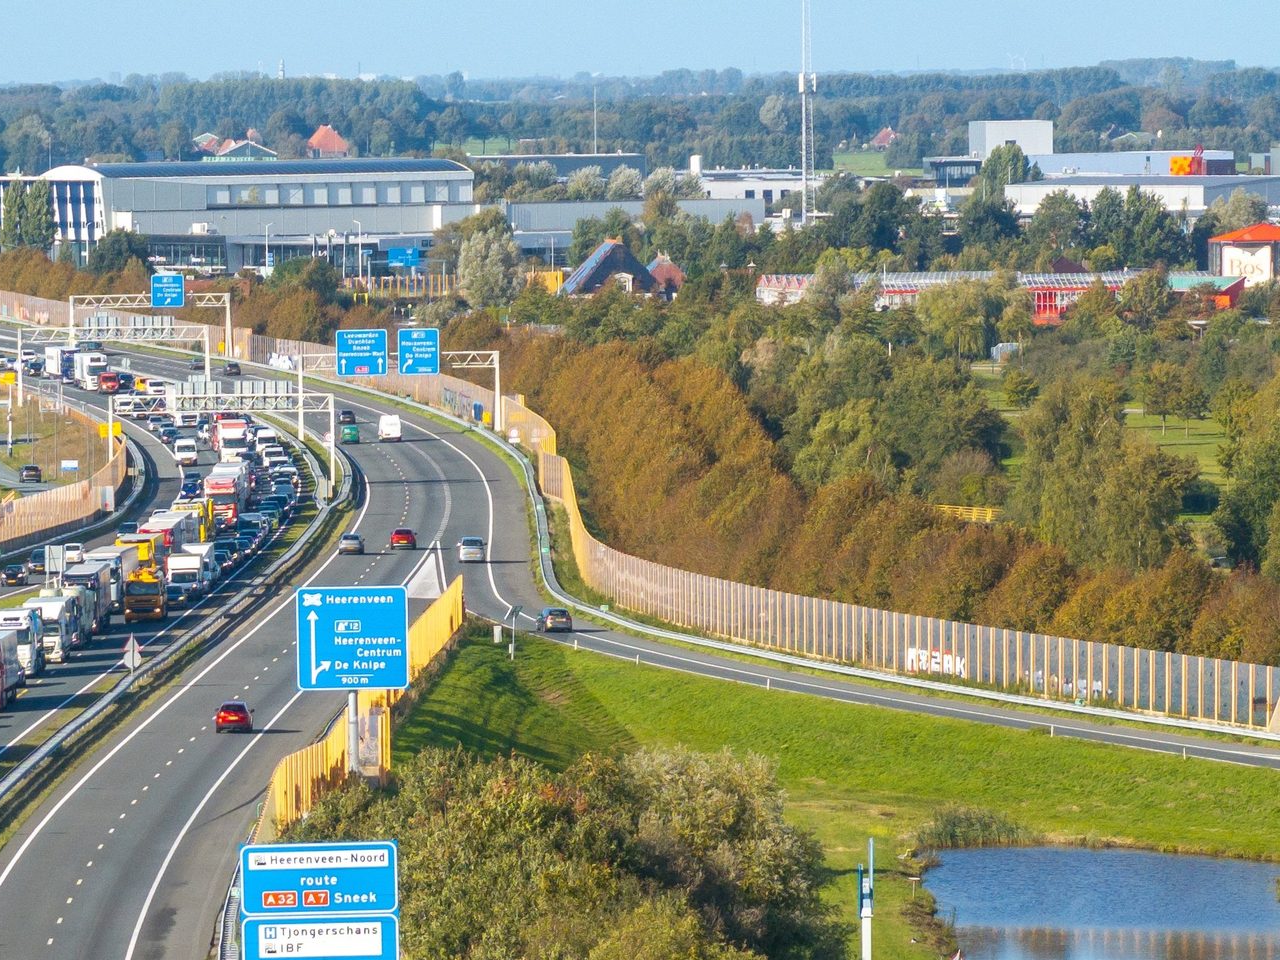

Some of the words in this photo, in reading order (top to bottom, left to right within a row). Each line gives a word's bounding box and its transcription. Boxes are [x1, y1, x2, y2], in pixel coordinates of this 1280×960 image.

[326, 595, 394, 604] Heerenveen
[334, 636, 402, 645] Heerenveen-
[356, 648, 402, 657] Centrum
[335, 661, 349, 670] De
[353, 661, 386, 671] Knipe
[270, 853, 385, 865] Heerenveen-Noord
[300, 875, 338, 886] route
[334, 892, 376, 903] Sneek
[280, 926, 378, 939] Tjongerschans
[280, 943, 303, 953] IBF
